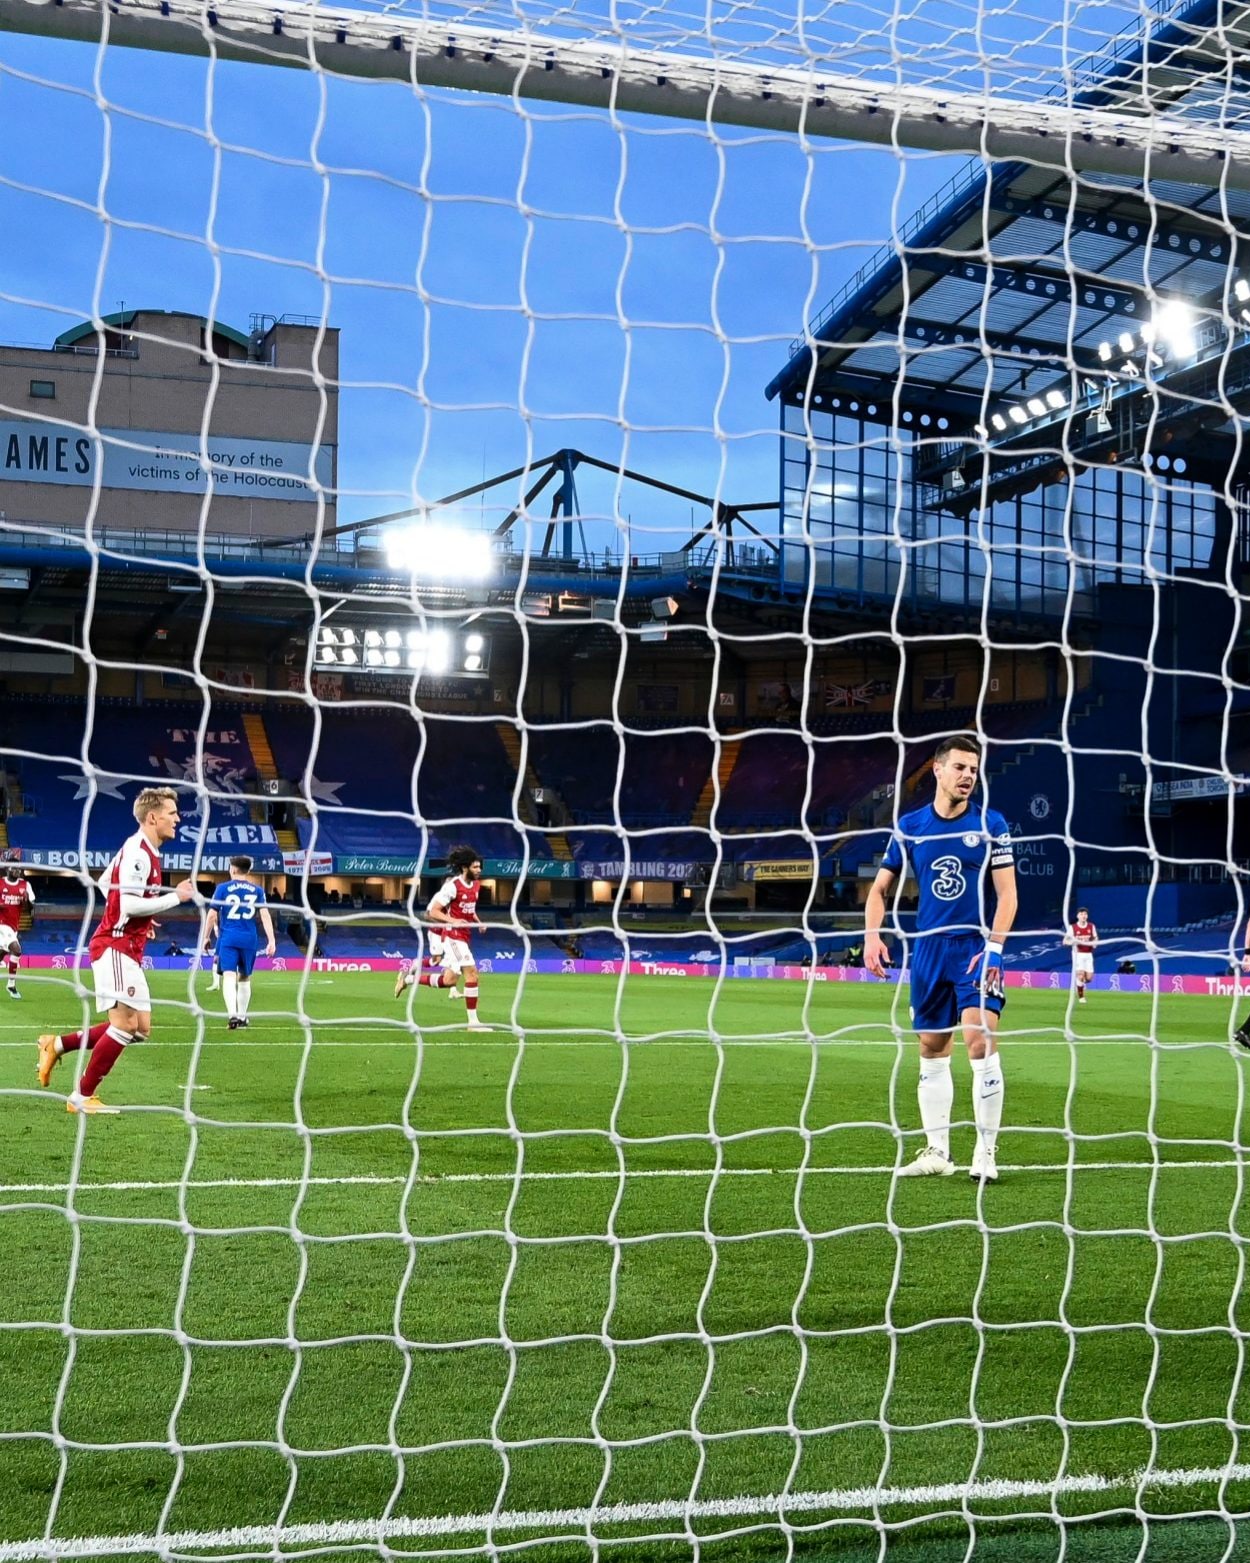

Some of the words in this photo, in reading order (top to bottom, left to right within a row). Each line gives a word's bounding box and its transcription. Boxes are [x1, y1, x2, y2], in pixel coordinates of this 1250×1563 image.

[6, 434, 90, 474] AMES
[240, 452, 255, 465] of
[260, 455, 283, 467] the
[128, 465, 180, 480] victims
[185, 468, 201, 481] of
[344, 857, 375, 871] Peter
[1016, 857, 1055, 876] CLUB
[225, 894, 257, 919] 23
[313, 958, 371, 972] Three
[641, 962, 686, 977] Three
